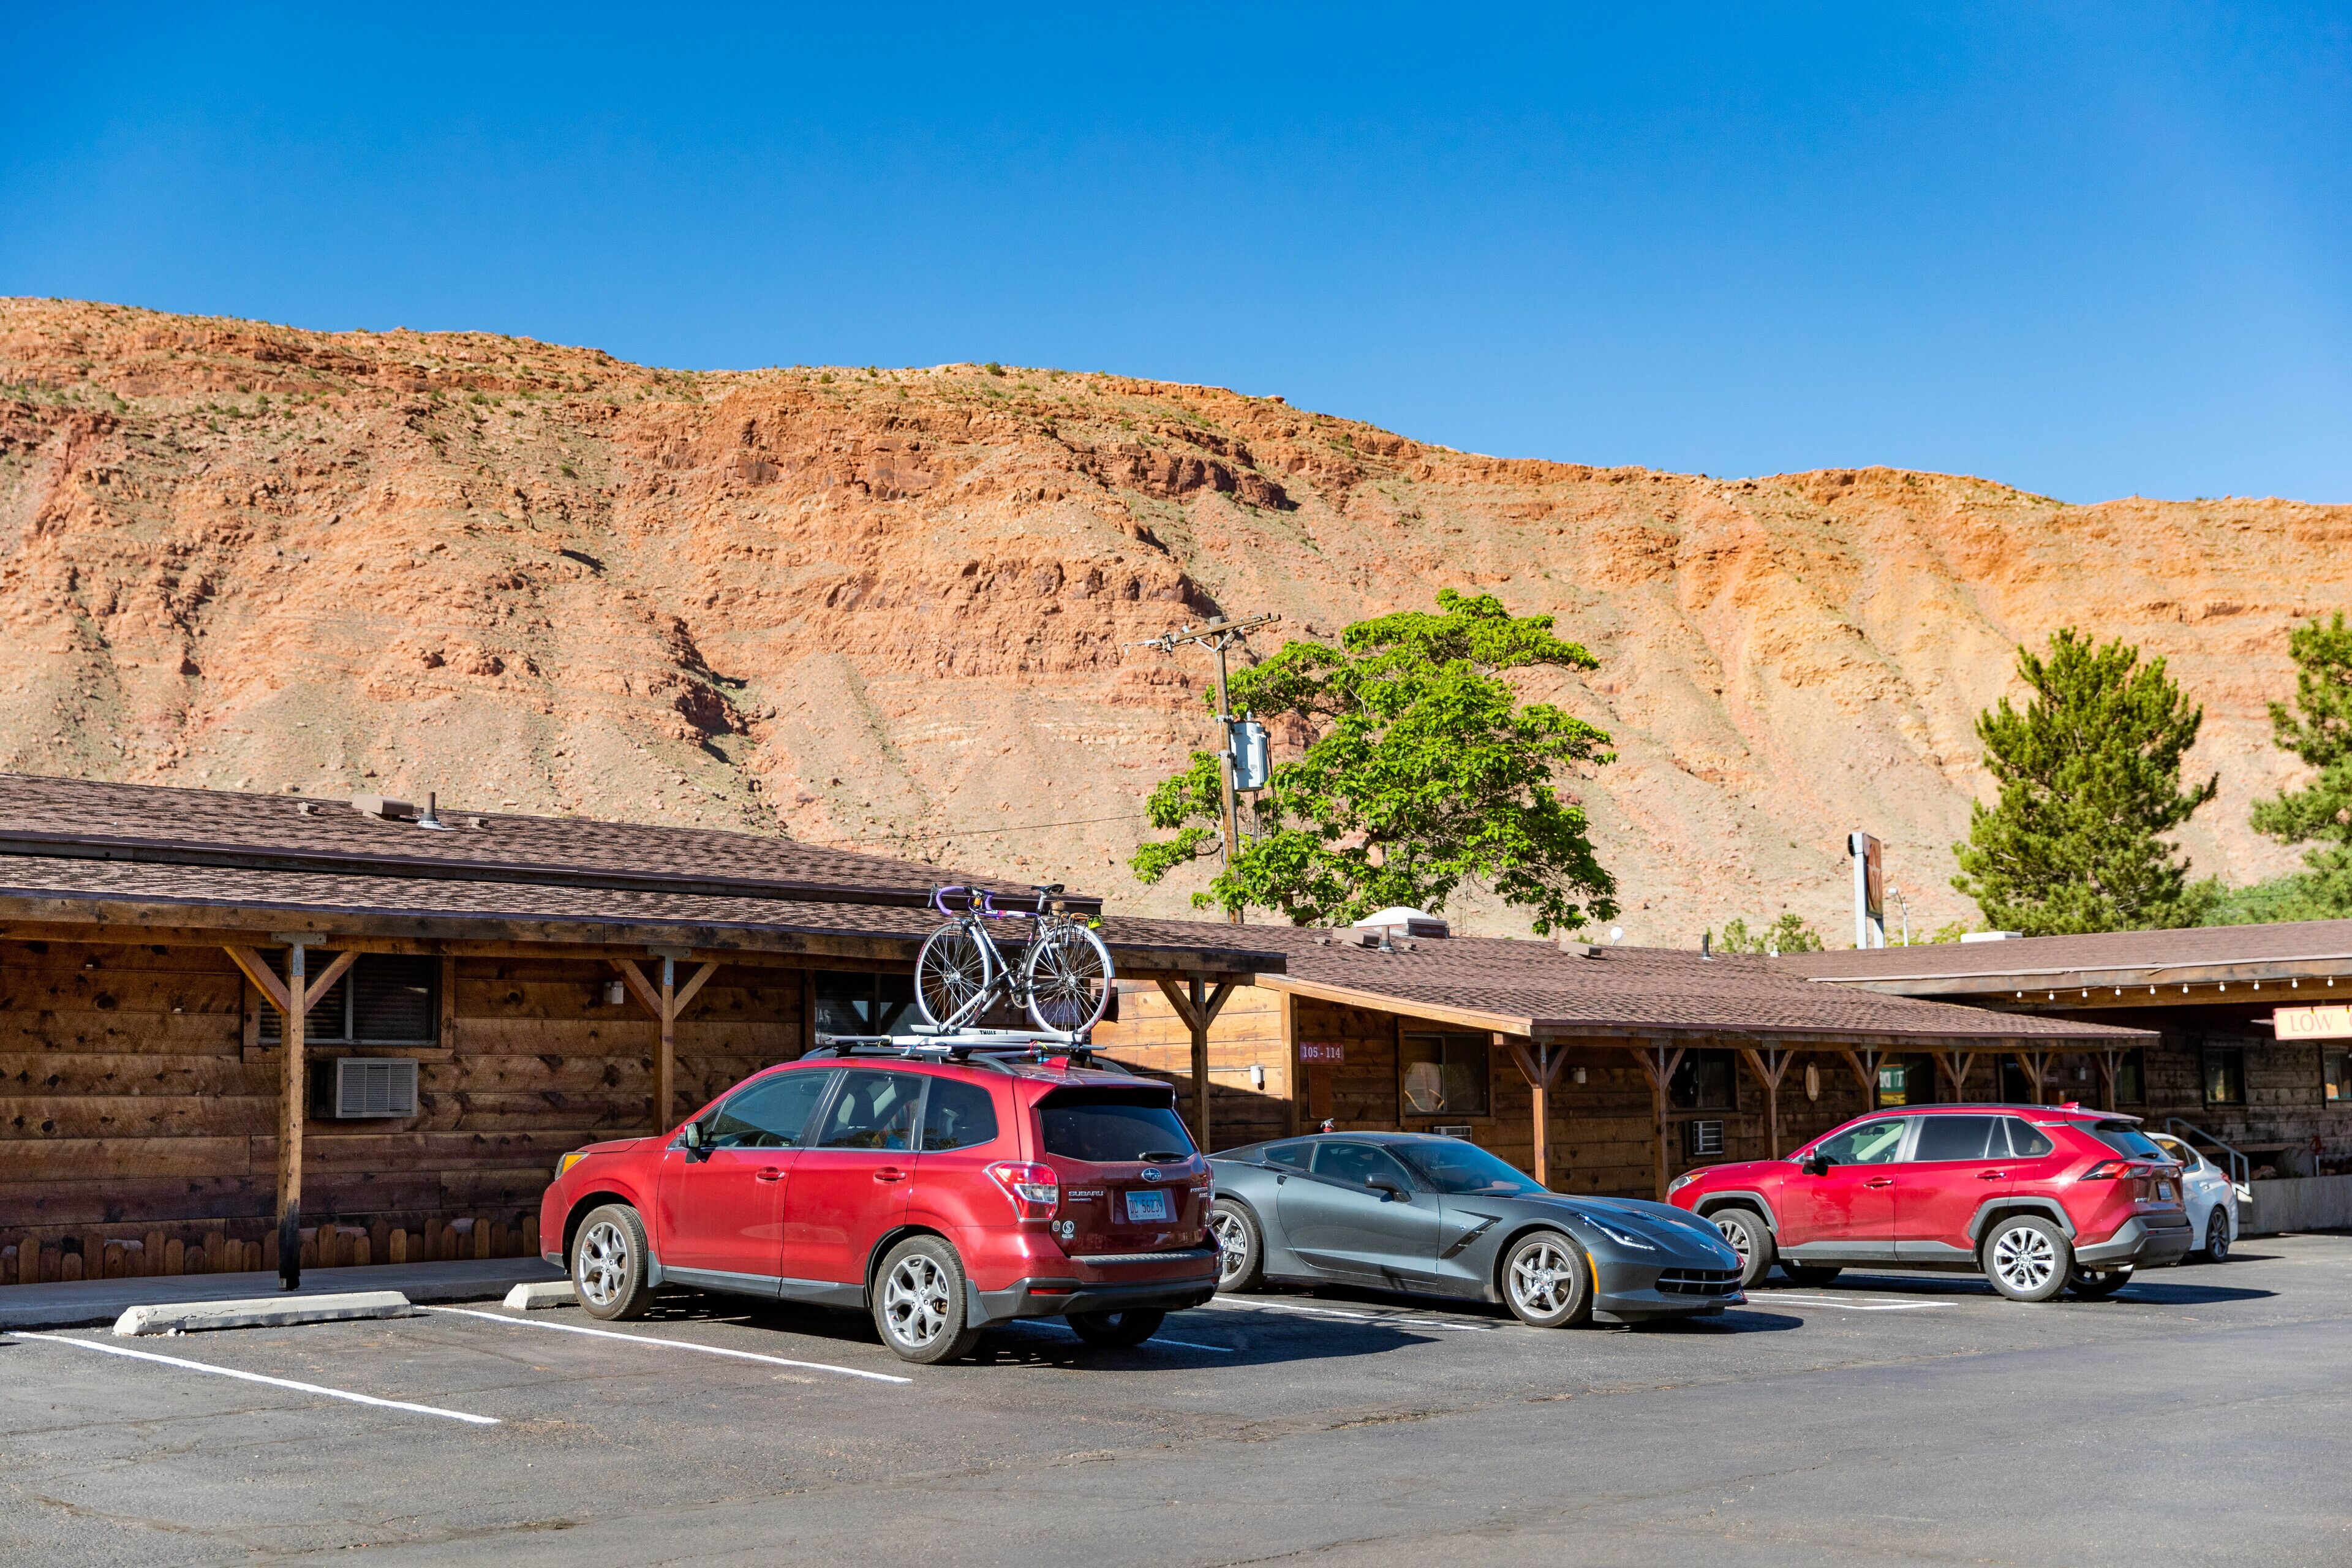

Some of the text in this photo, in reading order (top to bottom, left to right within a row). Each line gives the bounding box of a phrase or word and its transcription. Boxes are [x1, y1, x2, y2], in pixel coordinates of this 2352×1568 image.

[2290, 1013, 2334, 1032] LOW
[1303, 1046, 1318, 1058] 105
[1325, 1047, 1341, 1058] 114
[1142, 1199, 1163, 1213] 56239
